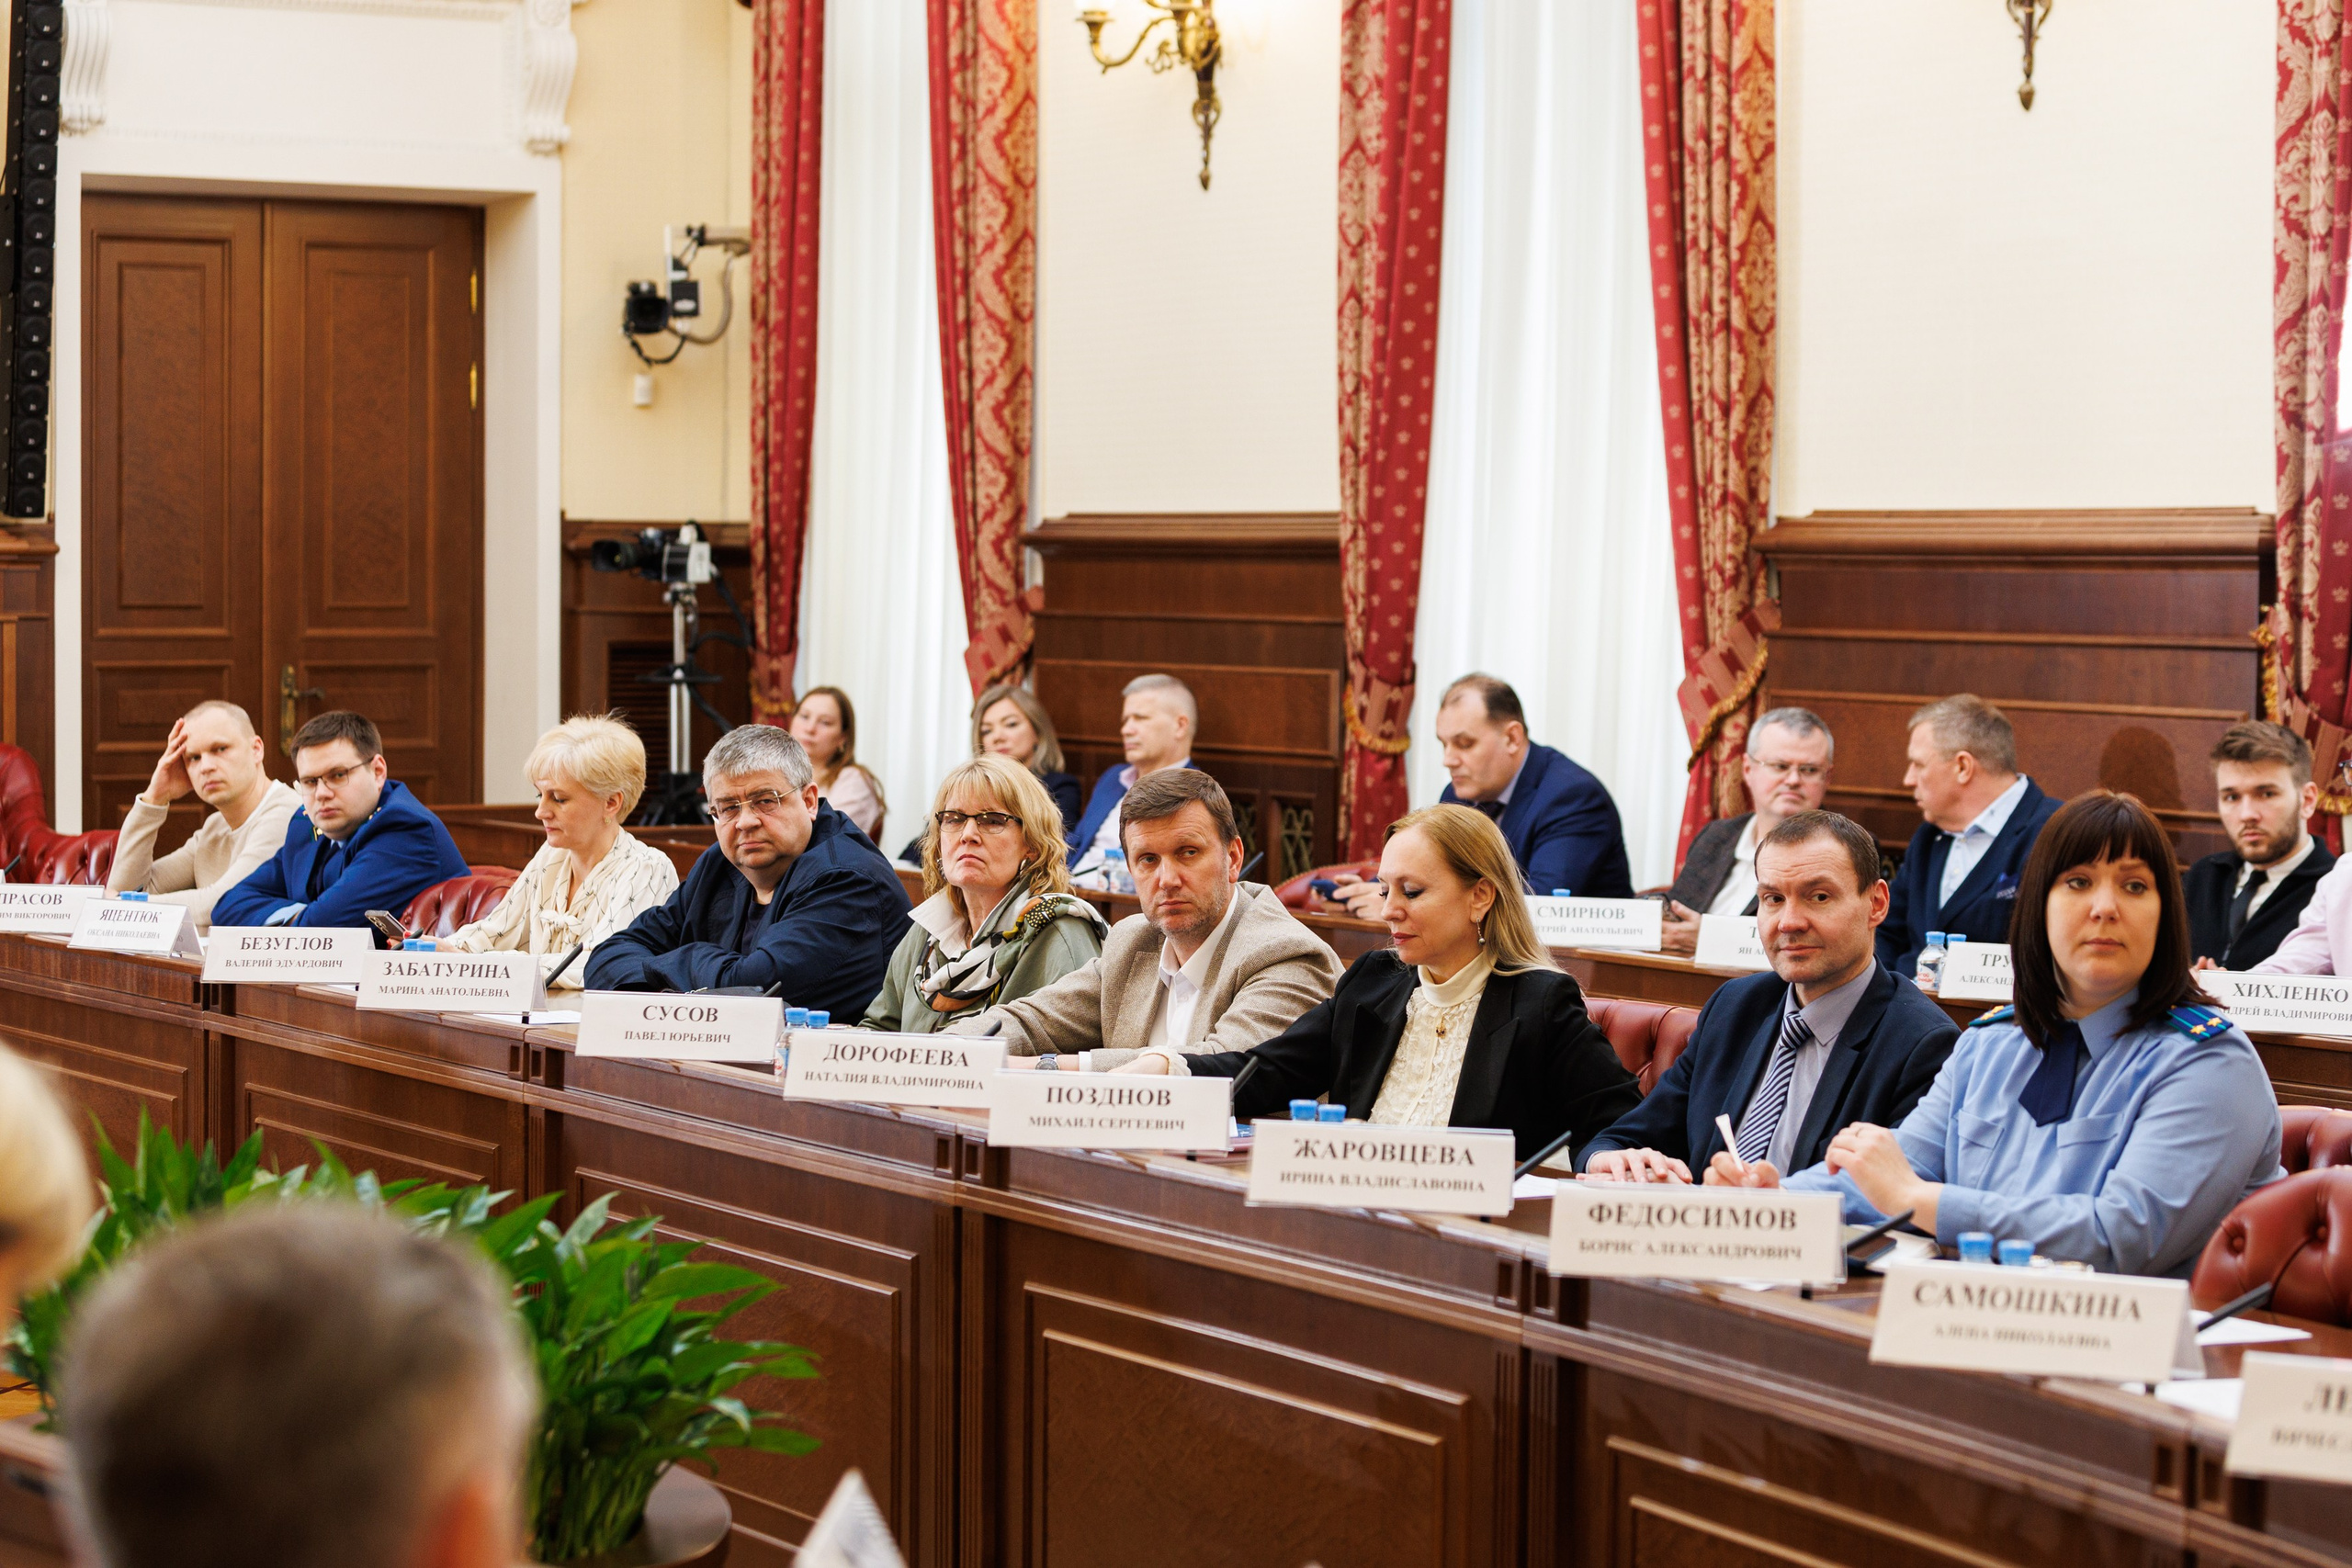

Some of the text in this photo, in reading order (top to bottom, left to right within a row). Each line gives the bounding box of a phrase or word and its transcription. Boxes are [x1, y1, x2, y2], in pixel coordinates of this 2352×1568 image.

[99, 908, 162, 923] ЯЦЕНТЮК
[1537, 906, 1625, 919] СМИРНОВ
[86, 928, 160, 939] ОКСАНА НИКОЛАЕВНА
[1570, 926, 1643, 935] АНАТОЛЬЕВИЧ
[240, 937, 334, 951] БЕЗУГЛОВ
[225, 957, 343, 968] ВАЛЕРИЙ ЭДУАРДОВИЧ
[382, 962, 511, 979] ЗАБАТУРИНА
[379, 986, 510, 998] МАРИНА АНАТОЛЬЕВНА
[2233, 983, 2349, 1003] ХИХЛЕНКО
[642, 1005, 718, 1022] СУСОВ
[624, 1031, 731, 1043] ПАВЕЛ ЮРЬЕВИЧ
[823, 1043, 969, 1066] ДОРОФЕЕВА
[805, 1071, 984, 1090] НАТАЛИЯ ВЛАДИМИРОВНА
[1046, 1087, 1171, 1108] ПОЗДНОВ
[1028, 1116, 1185, 1131] МИХАИЛ СЕРГЕЕВИЧ
[1294, 1138, 1475, 1167] ЖАРОВЦЕВА
[1280, 1170, 1486, 1191] ИРИНА ВЛАДИСЛАВОВНА
[1589, 1202, 1797, 1231] ФЕДОСИМОВ
[1579, 1239, 1802, 1260] БОРИС АЛЕКСАНДРОВИЧ
[1914, 1280, 2143, 1321] САМОШКИНА
